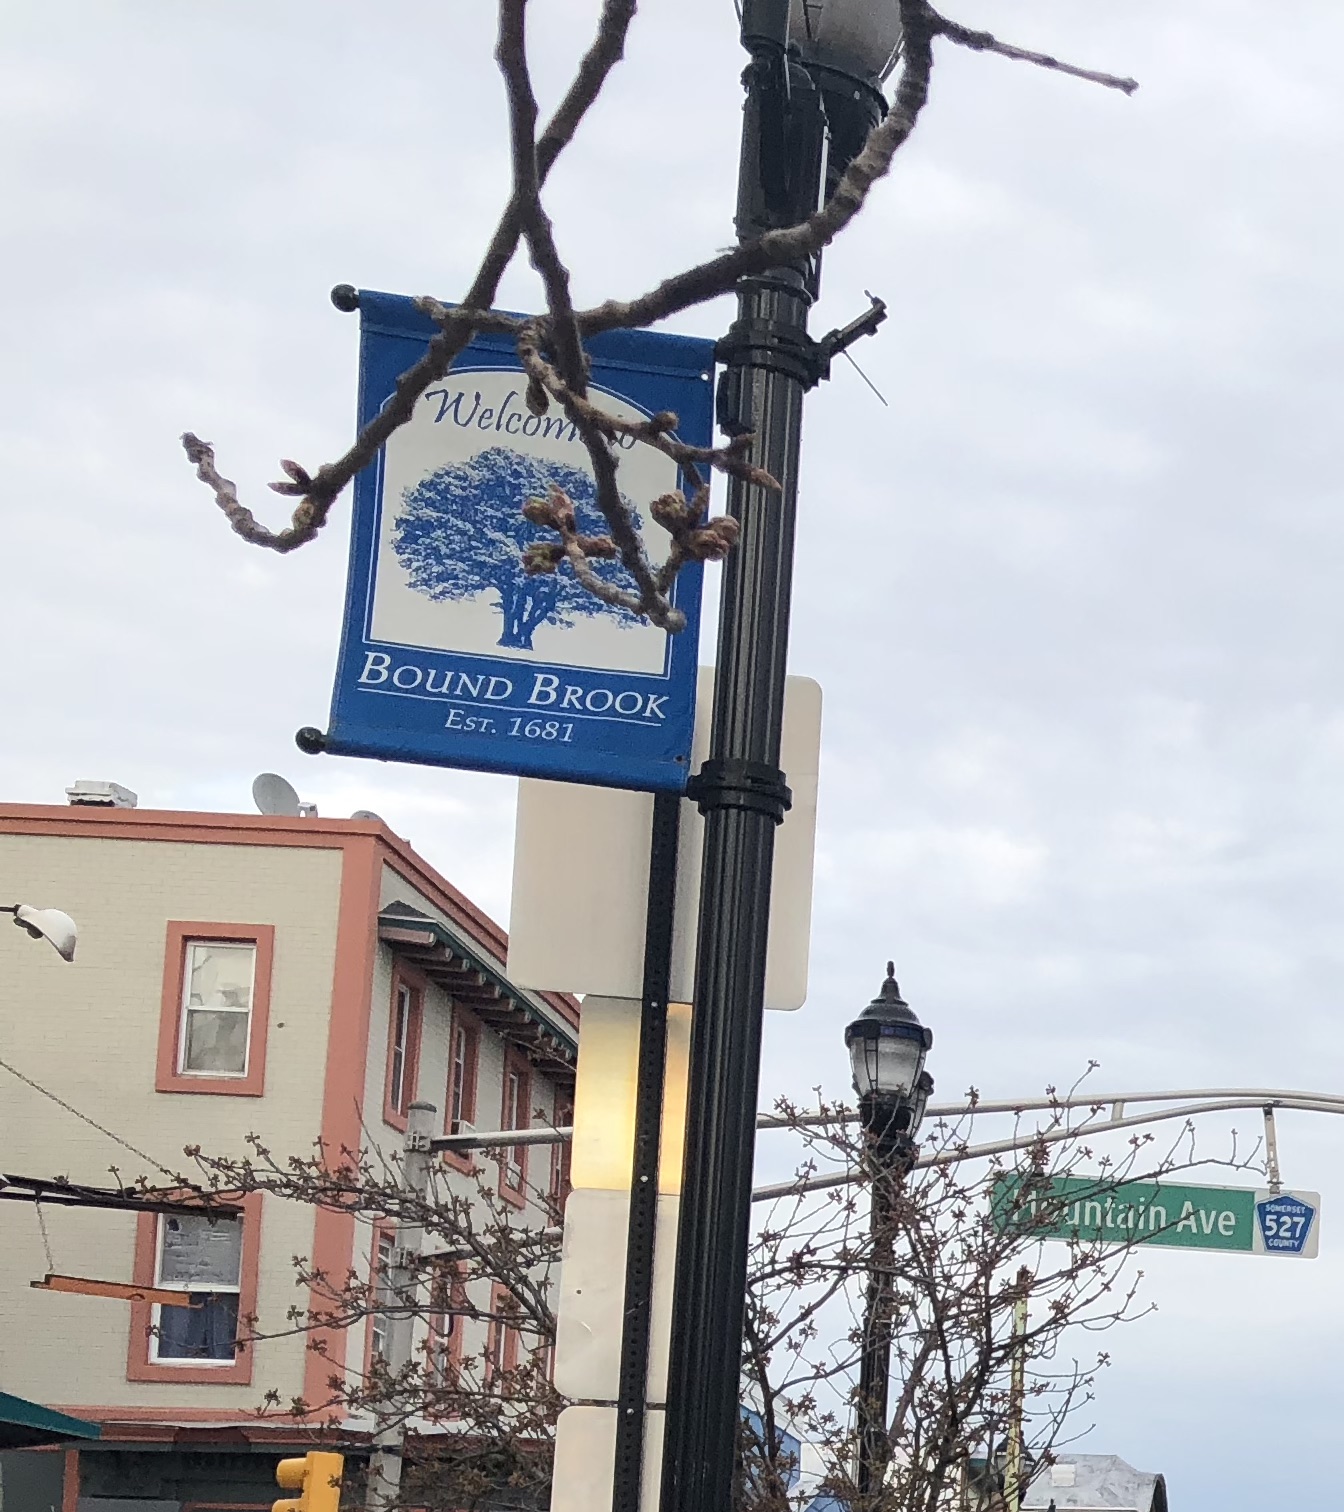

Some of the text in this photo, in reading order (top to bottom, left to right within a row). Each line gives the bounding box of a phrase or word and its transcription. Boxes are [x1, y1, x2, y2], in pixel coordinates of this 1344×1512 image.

[427, 388, 596, 443] Welcom
[358, 651, 669, 719] BOUND BROOK
[507, 717, 574, 742] 1681
[1176, 1201, 1236, 1236] Ave
[1265, 1204, 1306, 1214] SOMERSET
[1265, 1215, 1306, 1238] 527
[1268, 1239, 1300, 1248] COUNTY
